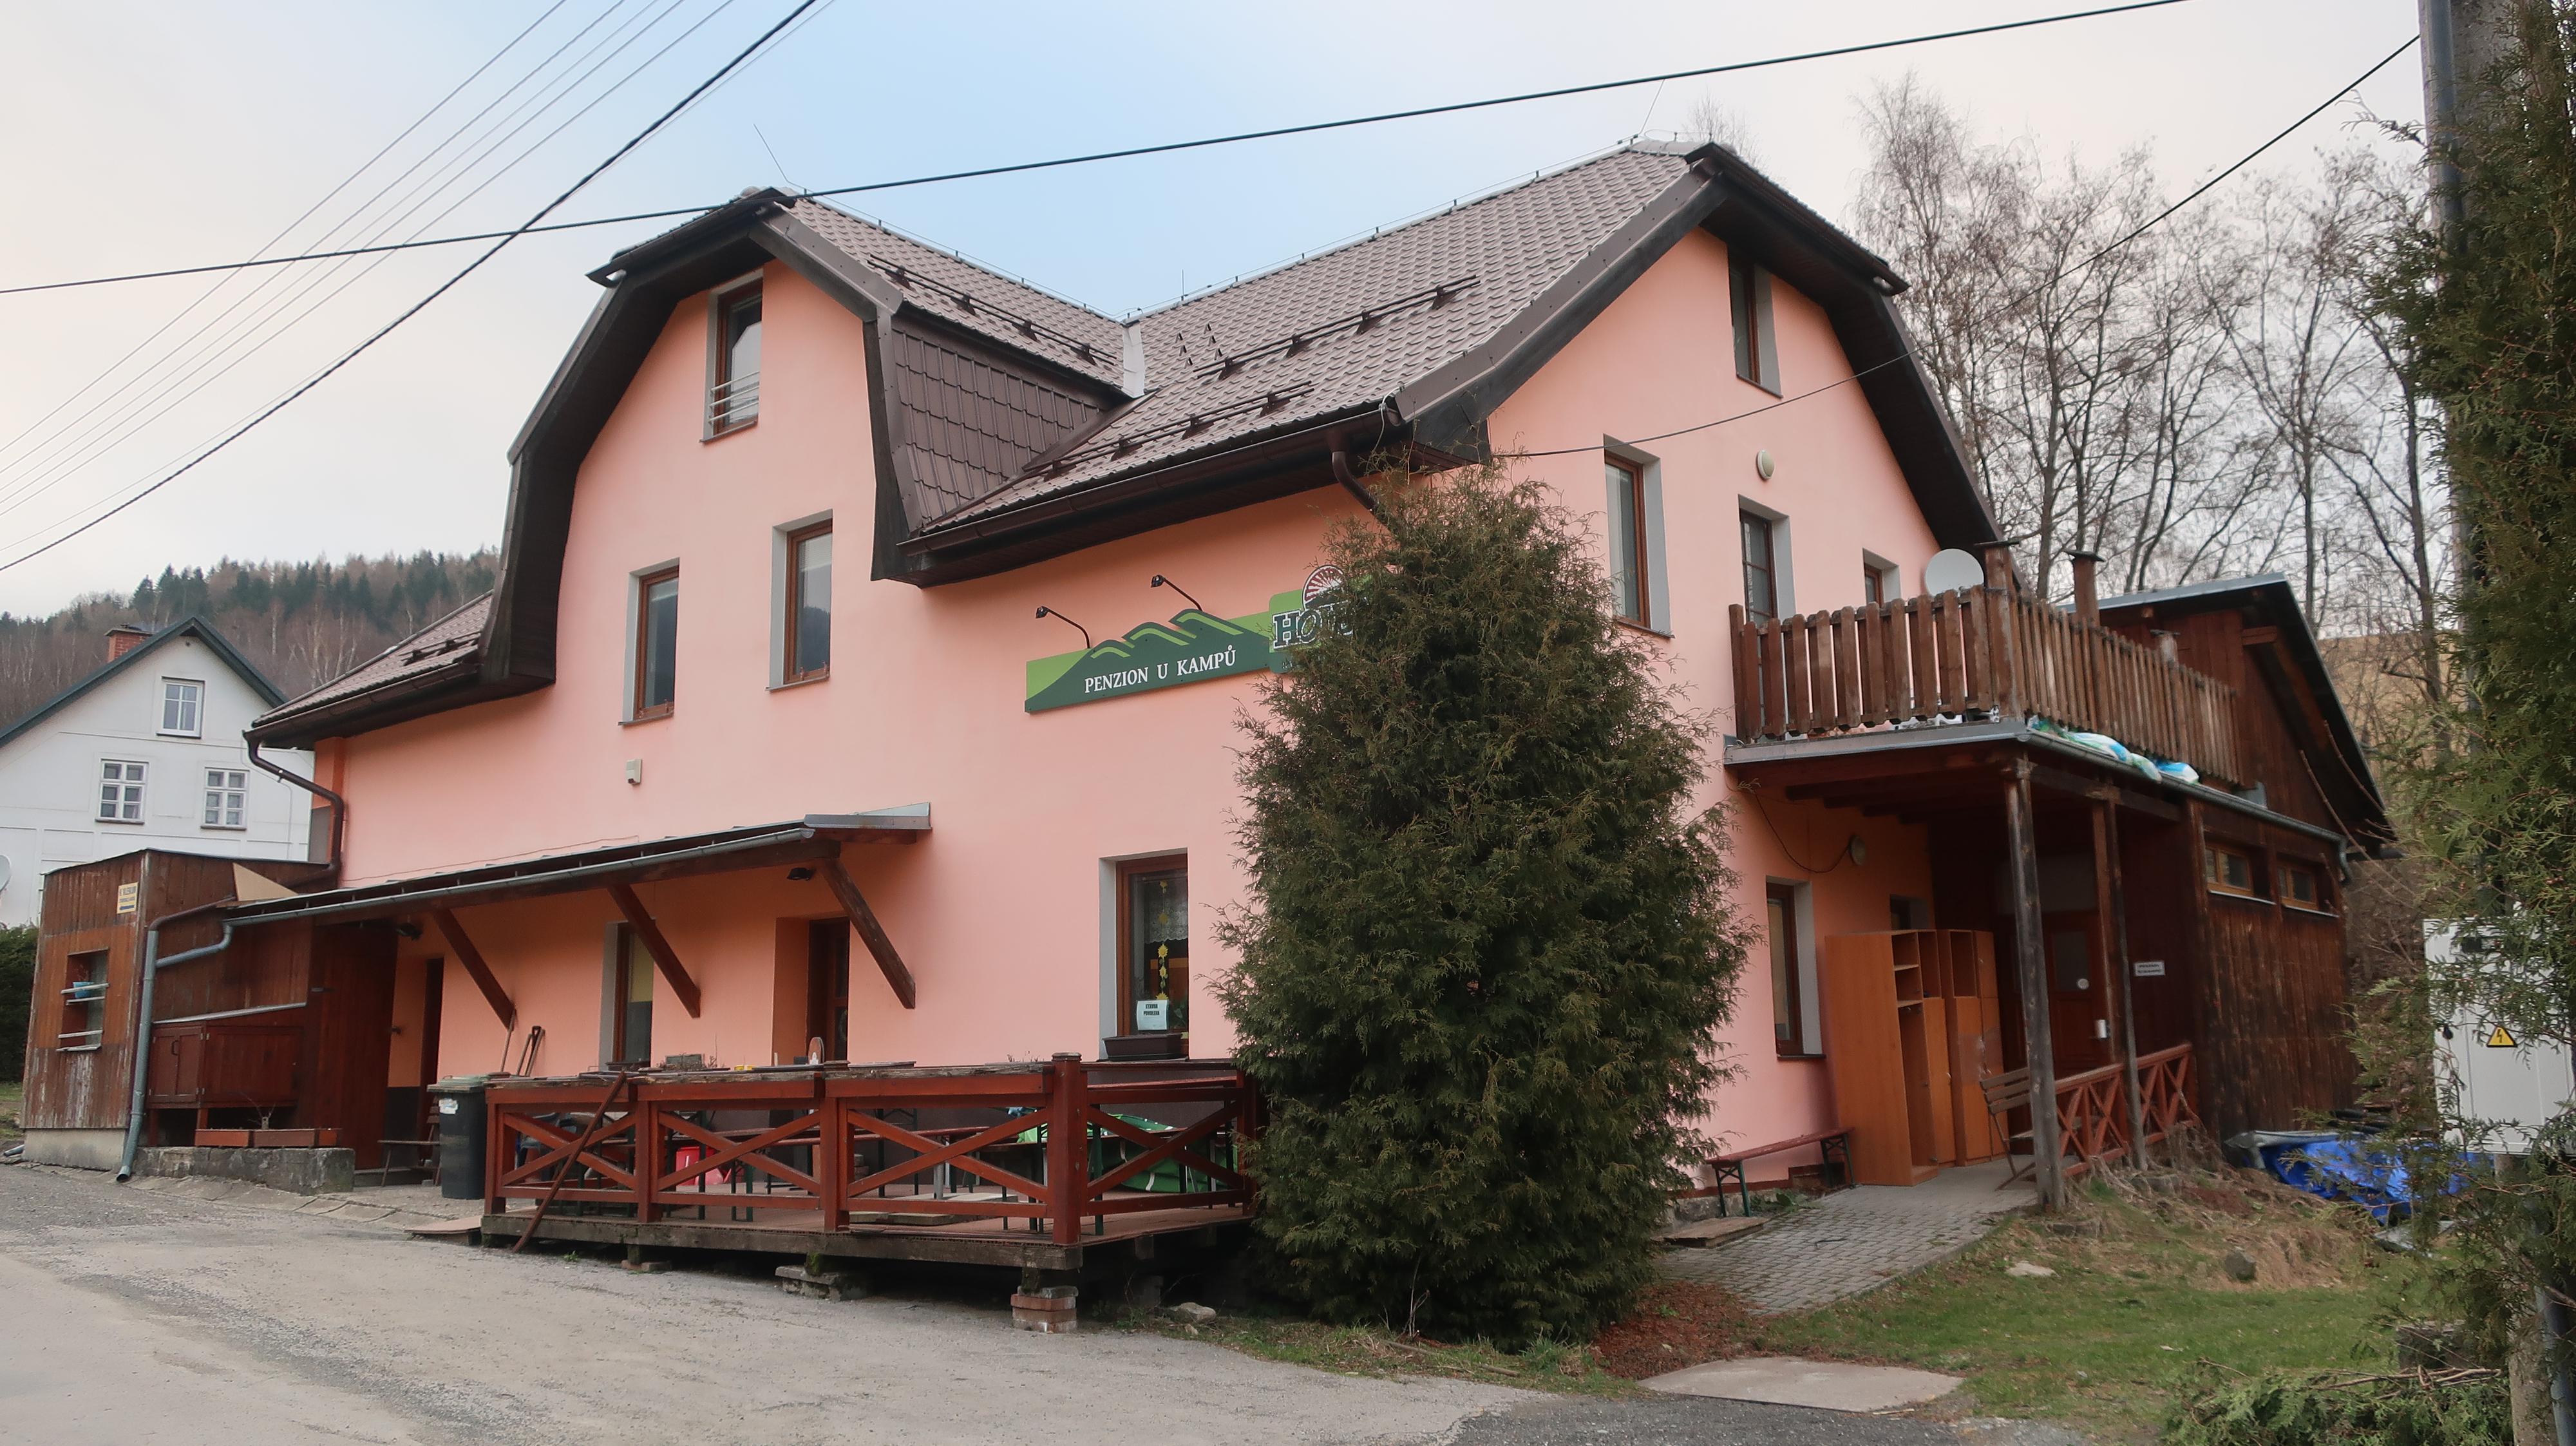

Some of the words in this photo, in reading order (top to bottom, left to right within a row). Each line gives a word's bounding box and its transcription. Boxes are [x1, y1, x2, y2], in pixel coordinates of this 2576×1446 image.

[1084, 667, 1148, 693] PENZION
[1157, 663, 1168, 680] U
[1177, 645, 1236, 676] KAMPŮ
